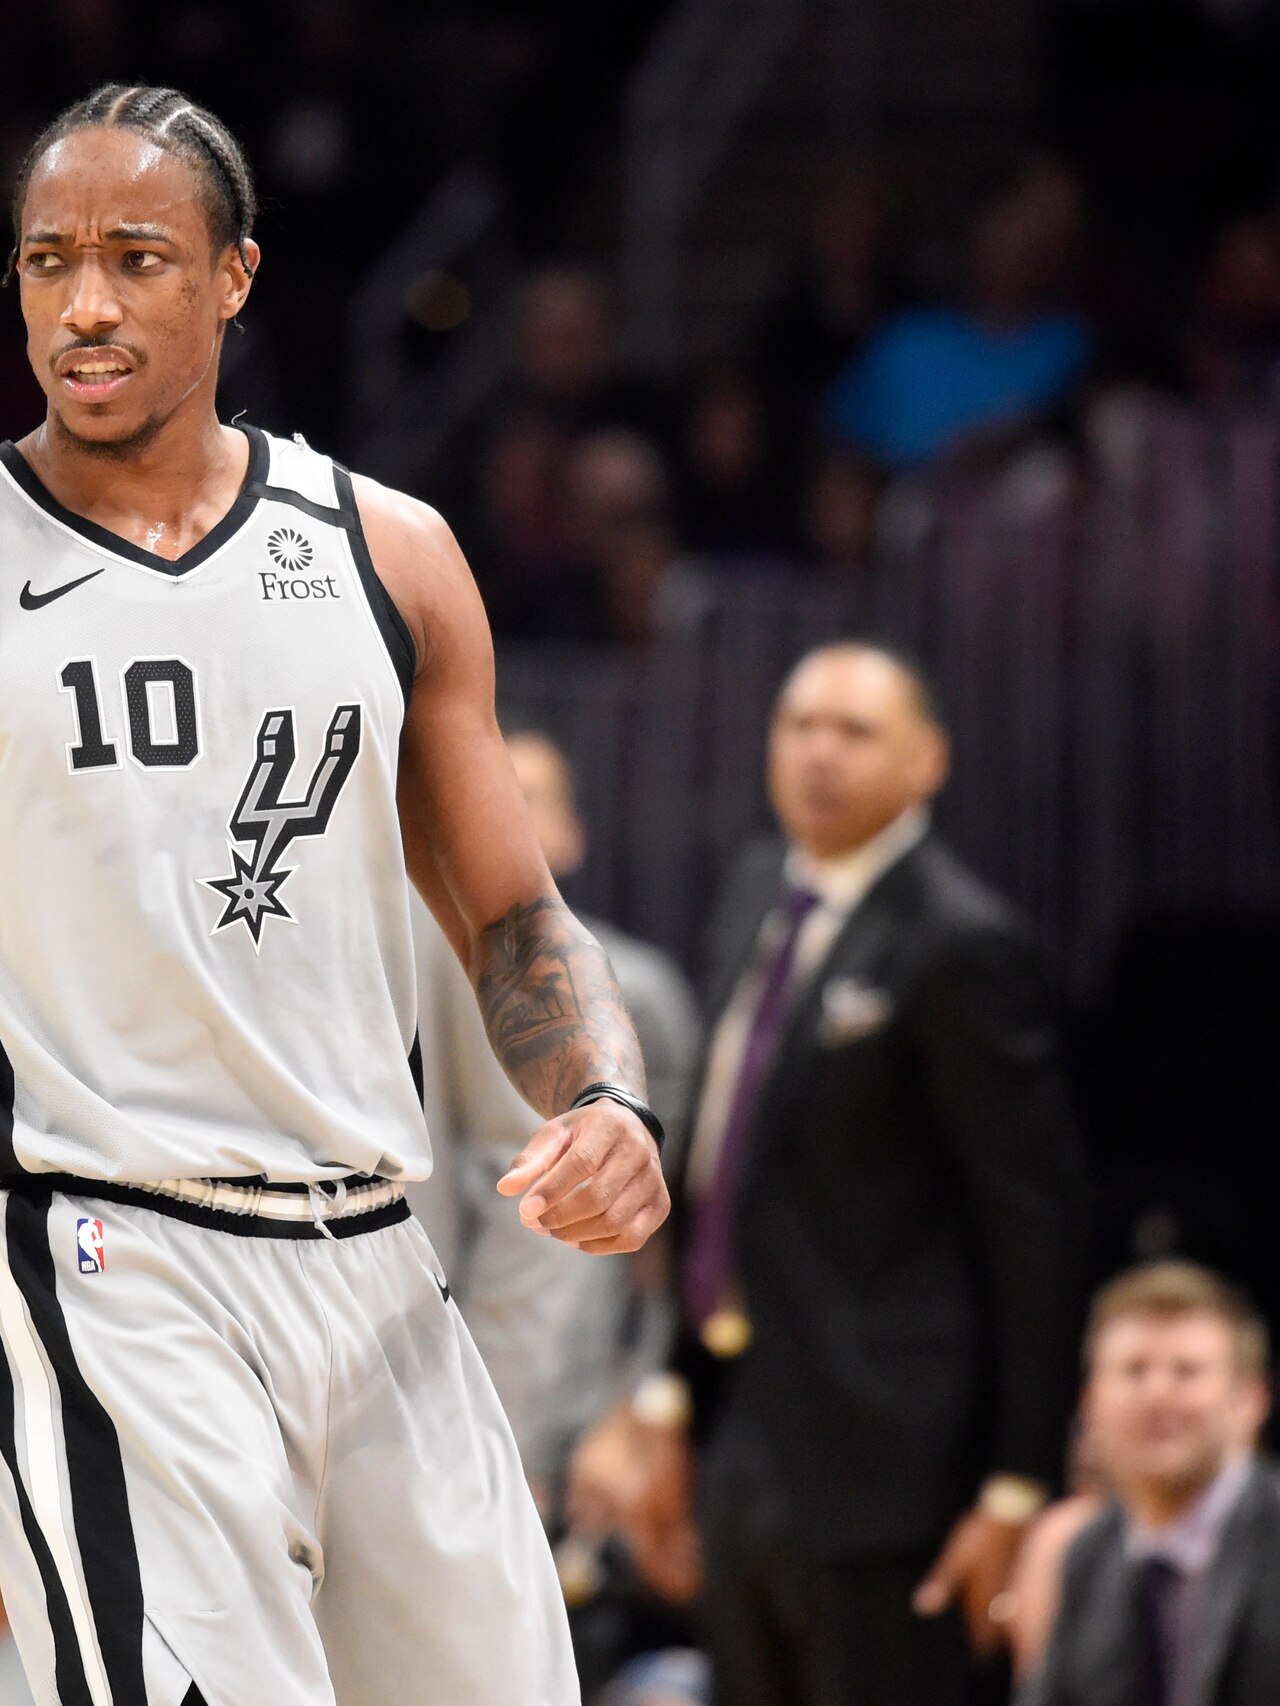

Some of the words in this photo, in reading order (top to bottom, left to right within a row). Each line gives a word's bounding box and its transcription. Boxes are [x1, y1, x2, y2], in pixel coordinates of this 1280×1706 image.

[258, 572, 341, 601] Frost
[57, 654, 204, 774] 10
[81, 1260, 96, 1272] NBA
